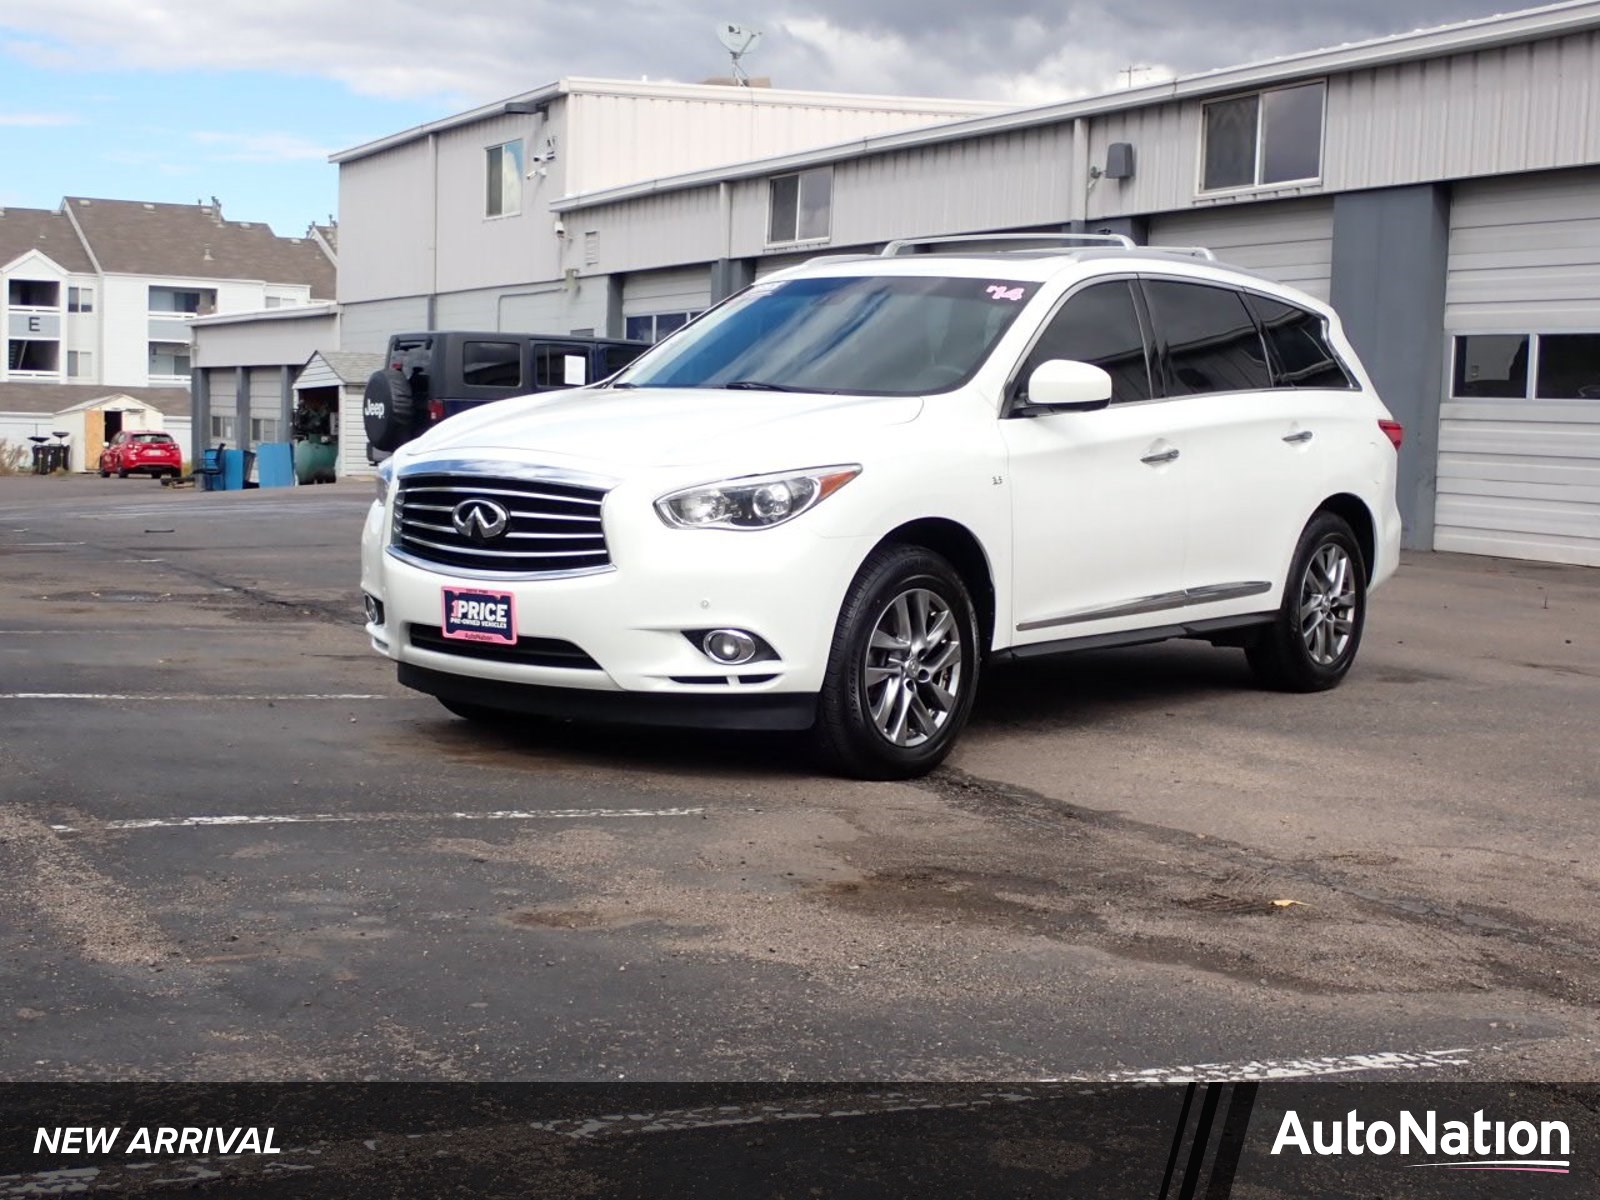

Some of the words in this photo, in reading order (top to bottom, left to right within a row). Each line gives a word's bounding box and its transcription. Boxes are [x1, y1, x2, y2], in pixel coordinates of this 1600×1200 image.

[29, 316, 40, 331] E
[365, 399, 385, 419] Jeep
[481, 620, 507, 629] VEHICLES
